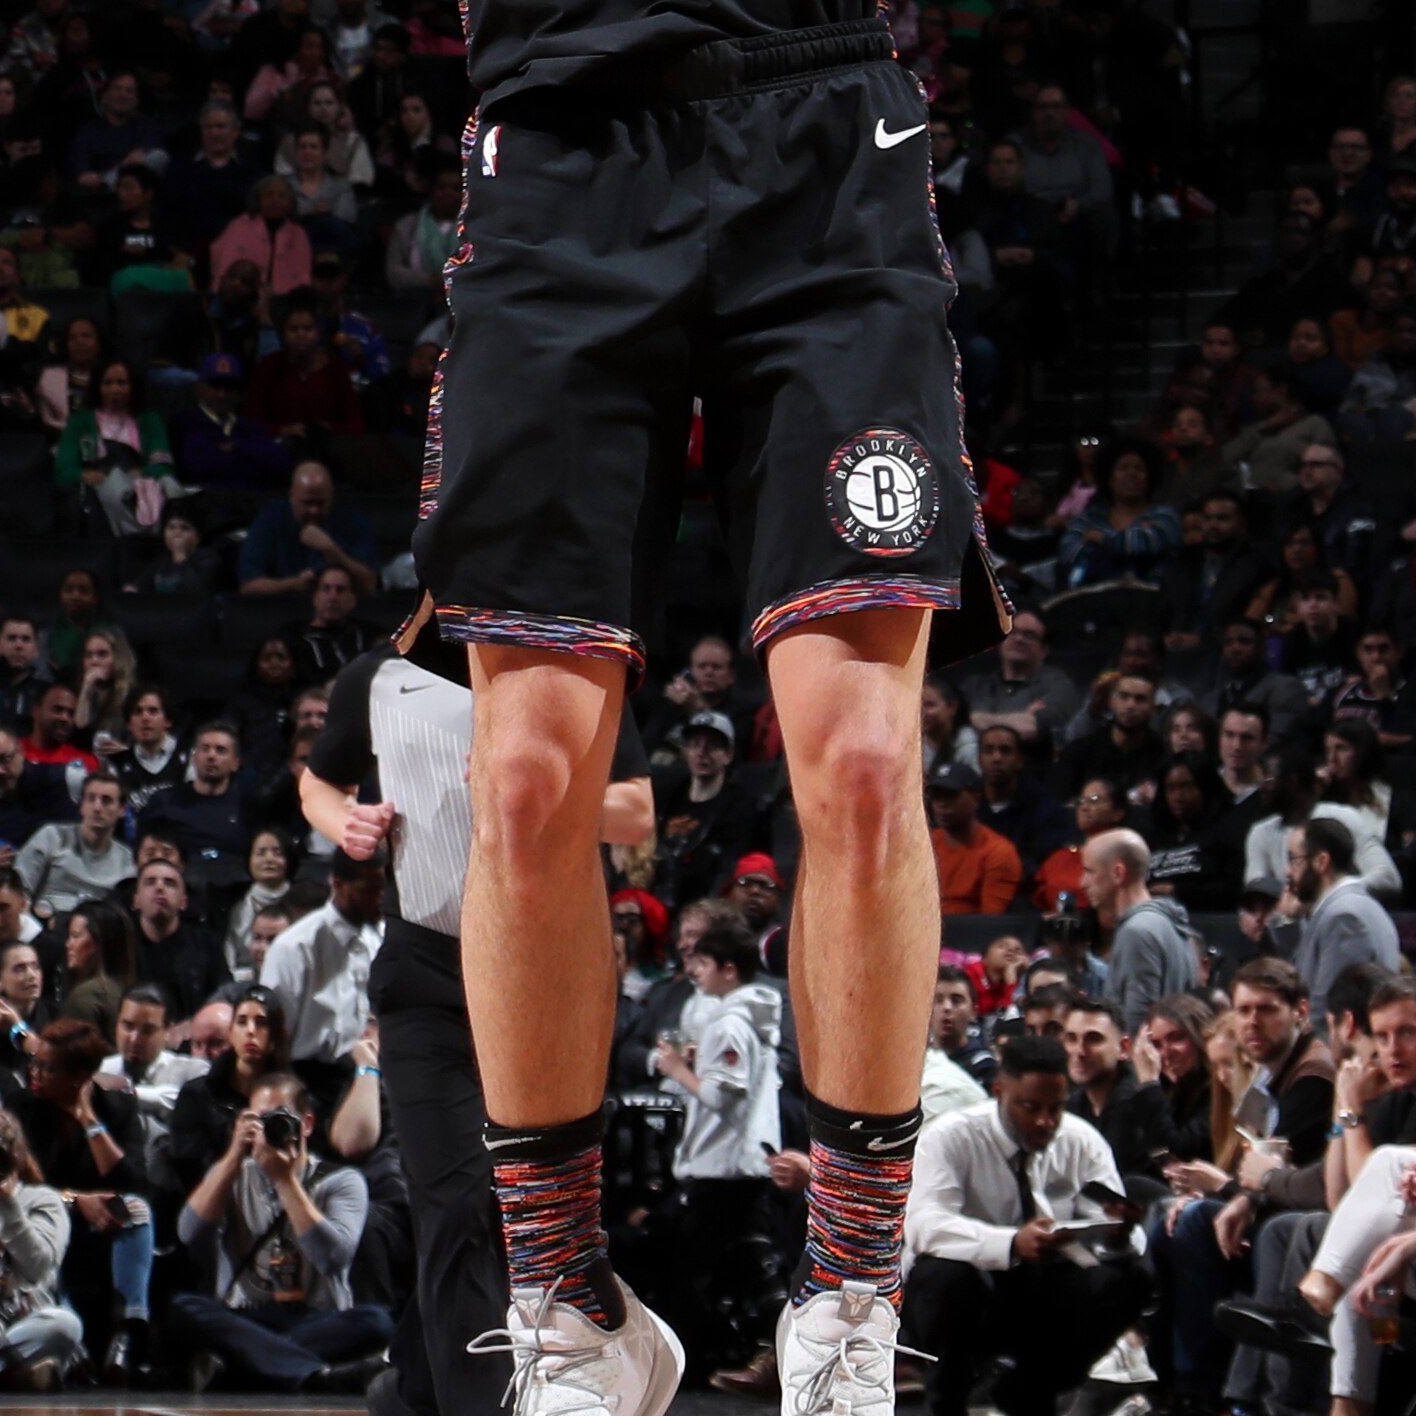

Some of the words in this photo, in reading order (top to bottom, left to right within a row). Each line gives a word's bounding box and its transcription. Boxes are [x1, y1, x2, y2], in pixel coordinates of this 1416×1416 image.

[835, 439, 927, 480] BROOKLYN
[872, 465, 900, 522] B
[843, 515, 881, 545] NEW
[891, 515, 929, 546] YORK
